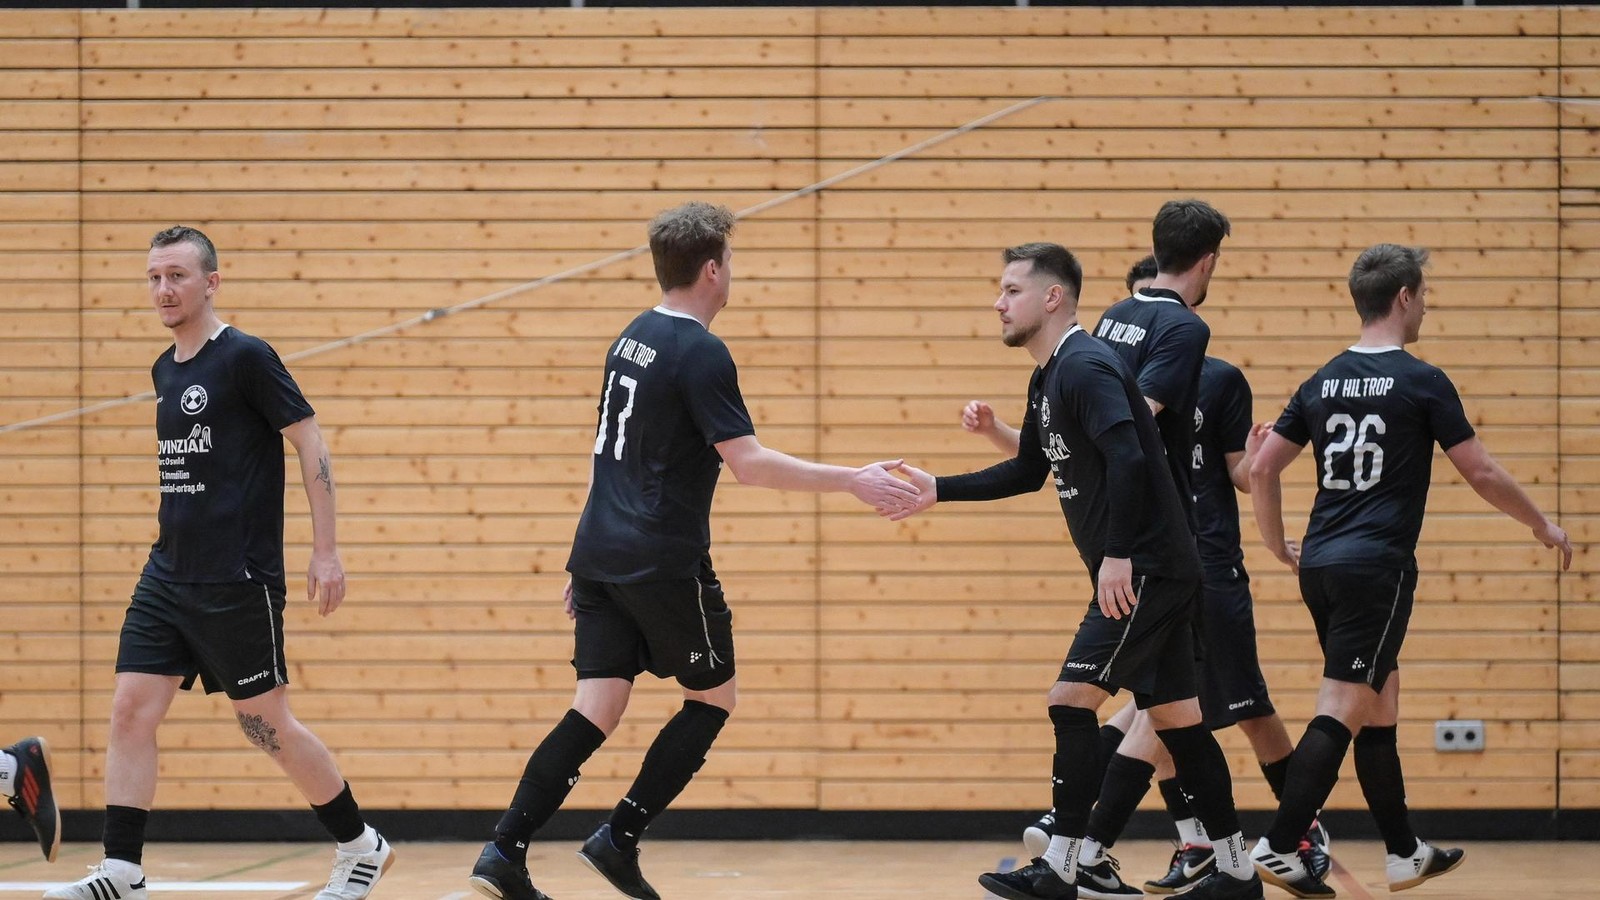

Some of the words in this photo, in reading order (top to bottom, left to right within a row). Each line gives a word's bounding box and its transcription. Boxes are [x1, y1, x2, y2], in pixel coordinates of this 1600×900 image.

[620, 338, 657, 369] HILTROP
[1321, 379, 1340, 399] BV
[1341, 377, 1395, 398] HILTROP
[594, 370, 638, 461] 17
[1322, 413, 1387, 491] 26
[237, 672, 263, 686] CRAFT
[1066, 662, 1091, 670] CRAFT
